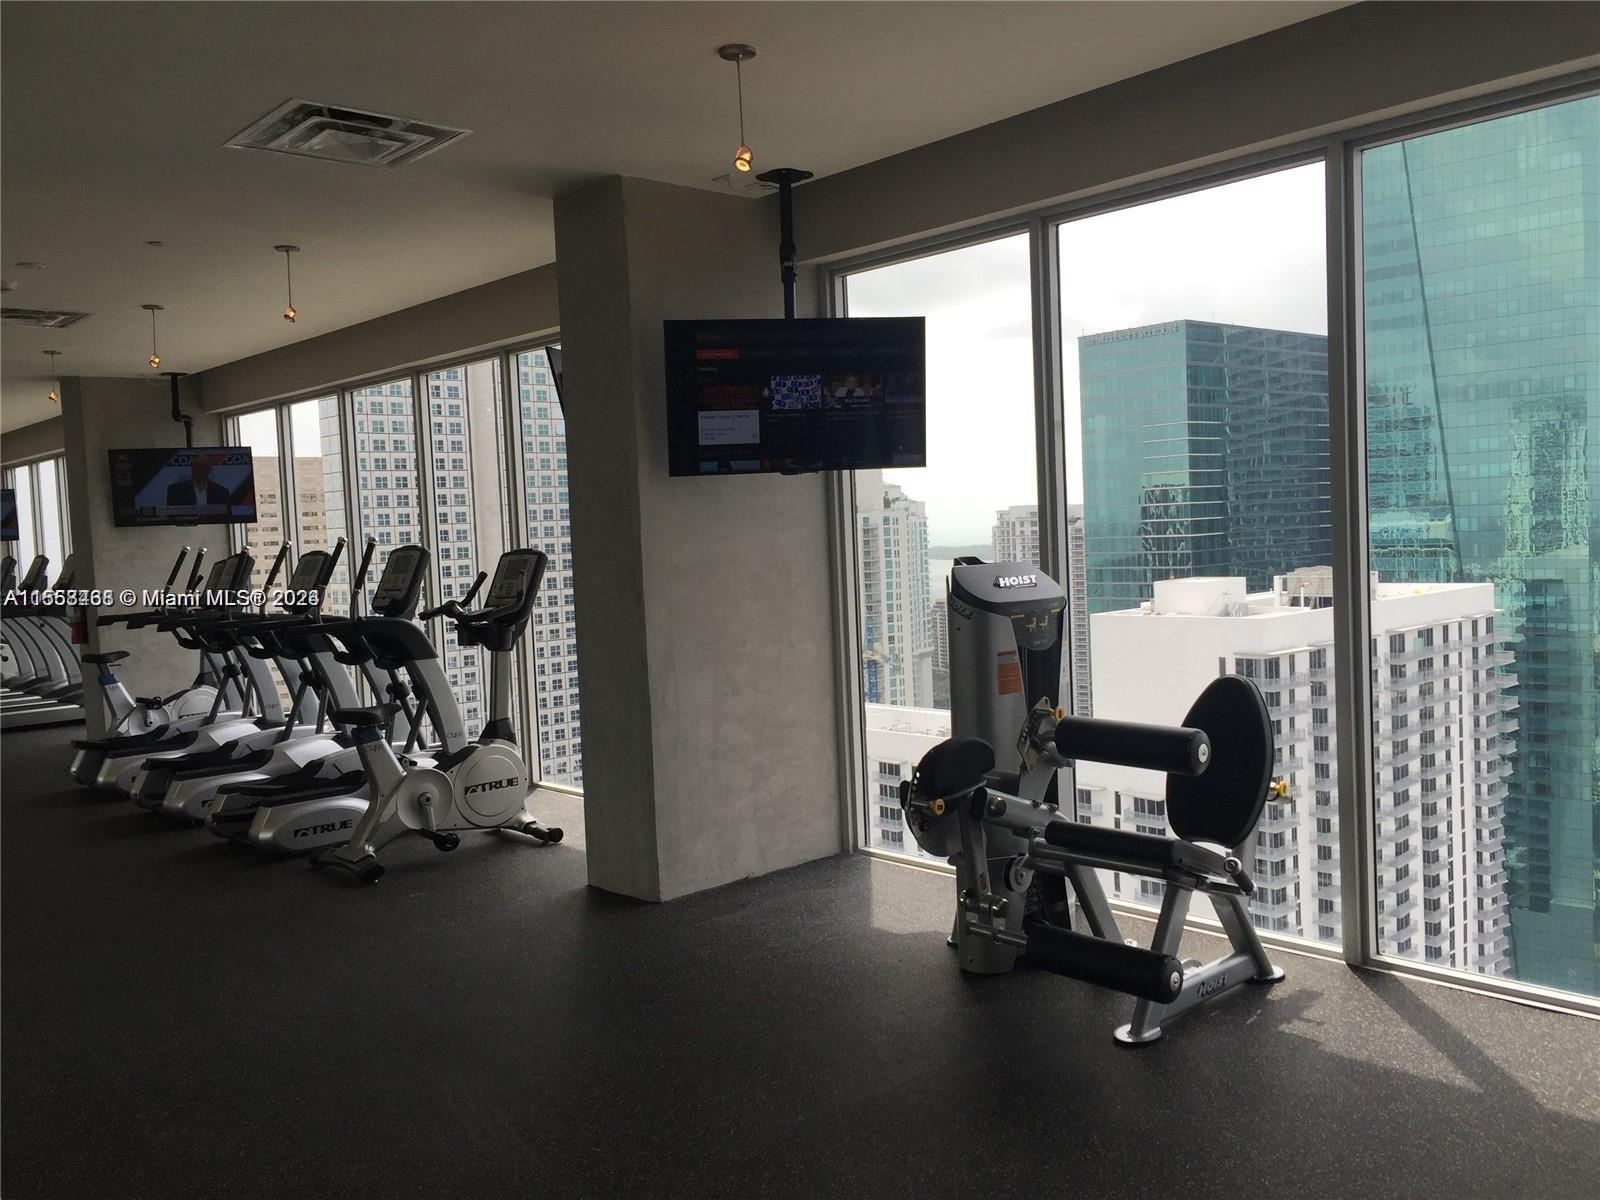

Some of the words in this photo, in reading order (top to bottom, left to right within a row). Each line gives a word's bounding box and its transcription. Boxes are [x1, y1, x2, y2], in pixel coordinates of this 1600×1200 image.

[998, 574, 1037, 588] HOIST
[477, 777, 519, 793] TRUE
[308, 819, 352, 836] TRUE
